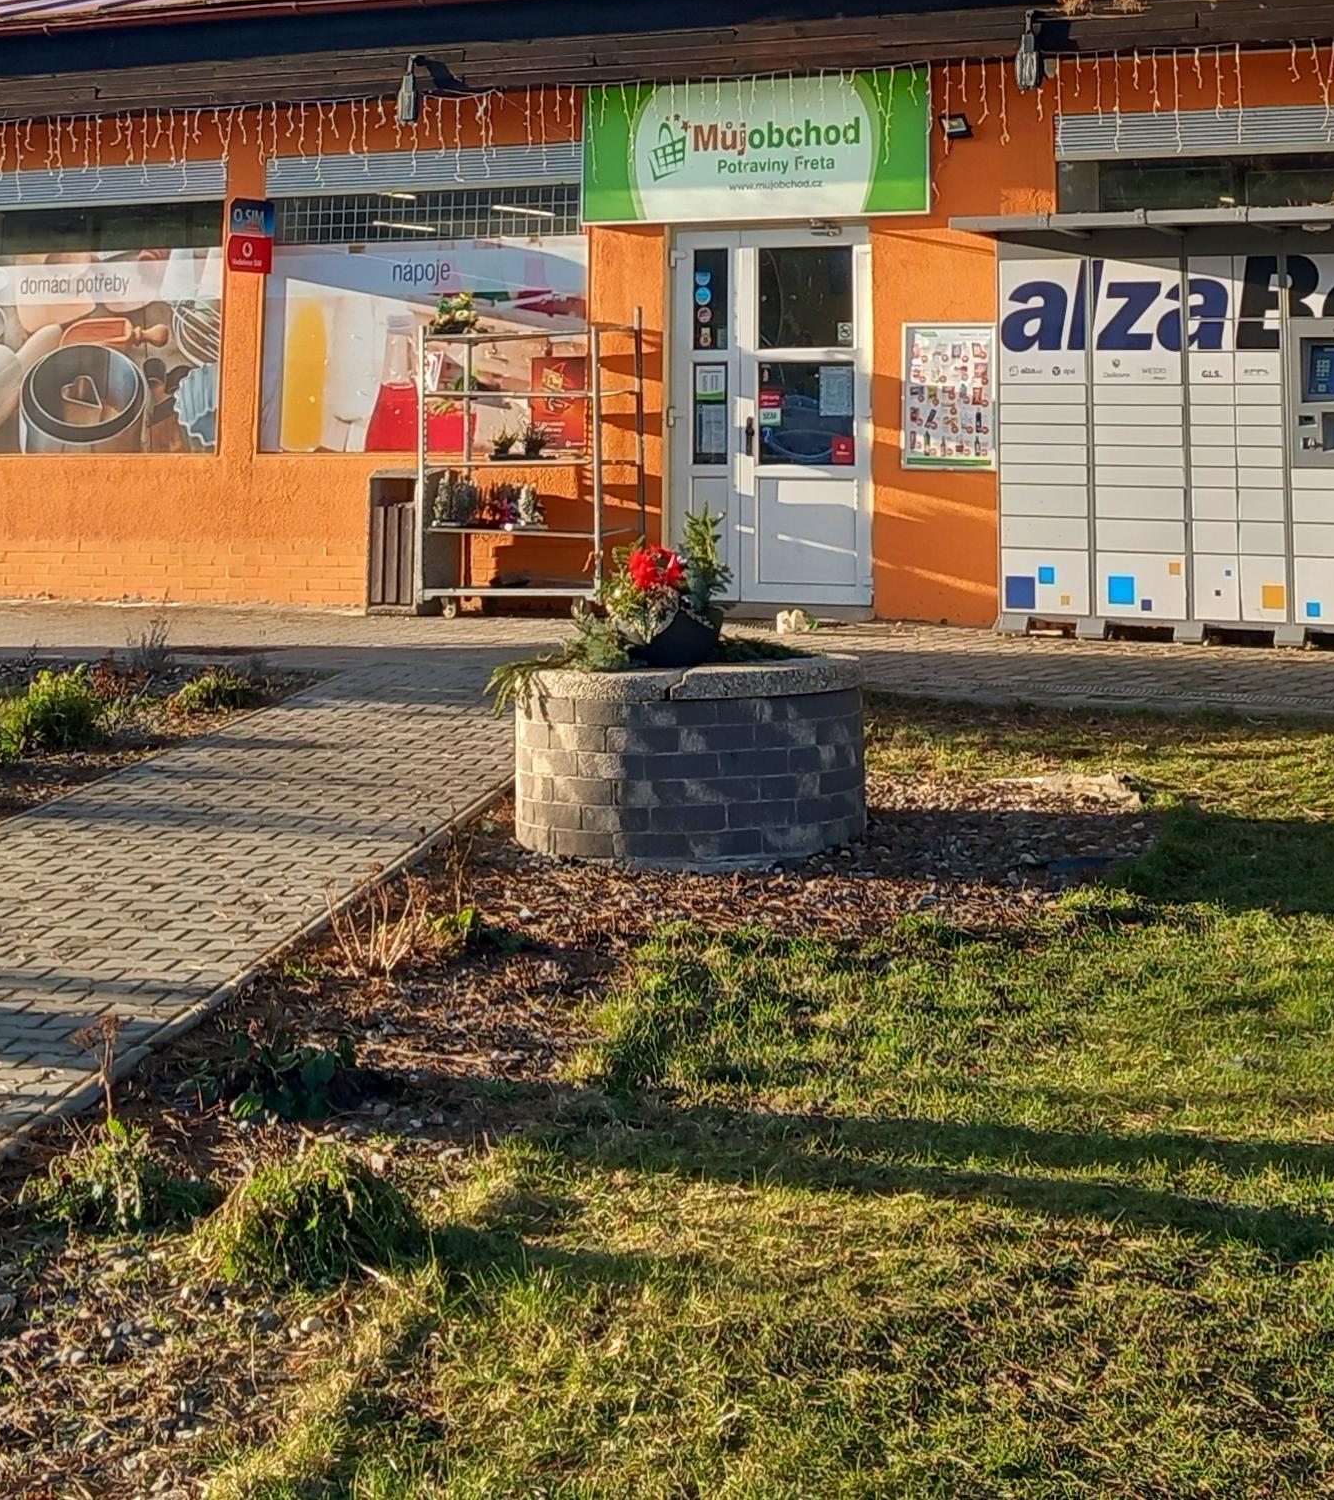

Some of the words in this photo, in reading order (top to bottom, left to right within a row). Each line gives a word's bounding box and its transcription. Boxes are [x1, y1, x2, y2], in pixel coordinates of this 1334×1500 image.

[717, 158, 789, 175] Potraviny
[794, 156, 835, 171] Freta
[728, 180, 823, 191] www.mujobchod.cz
[392, 258, 451, 287] nápoje
[20, 273, 71, 295] domácí
[76, 272, 130, 296] potřeby
